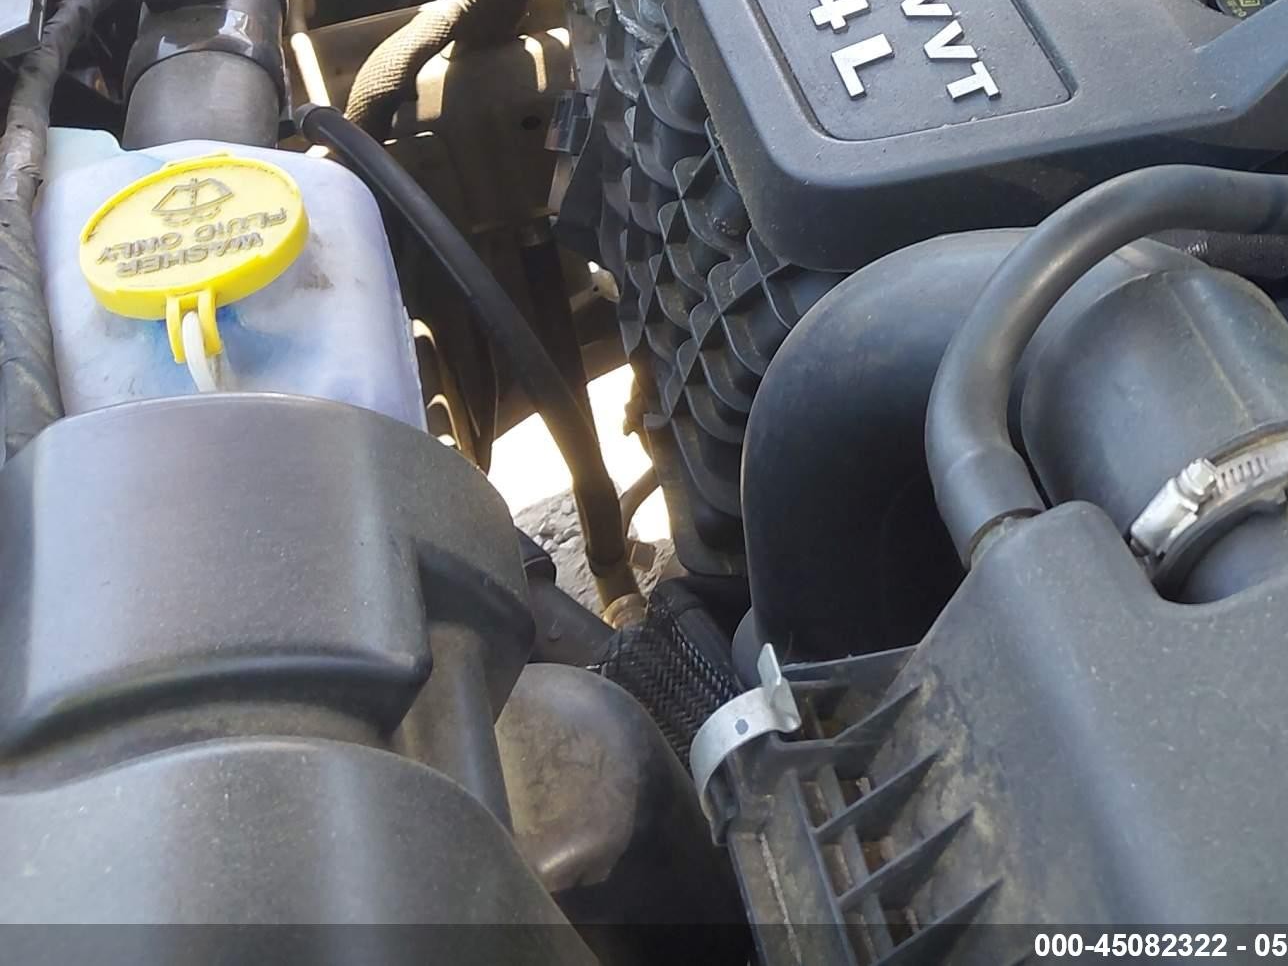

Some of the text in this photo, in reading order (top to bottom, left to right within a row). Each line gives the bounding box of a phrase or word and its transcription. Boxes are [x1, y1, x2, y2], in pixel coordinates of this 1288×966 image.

[96, 207, 288, 264] FLUID ONLY
[116, 232, 264, 277] WASHER
